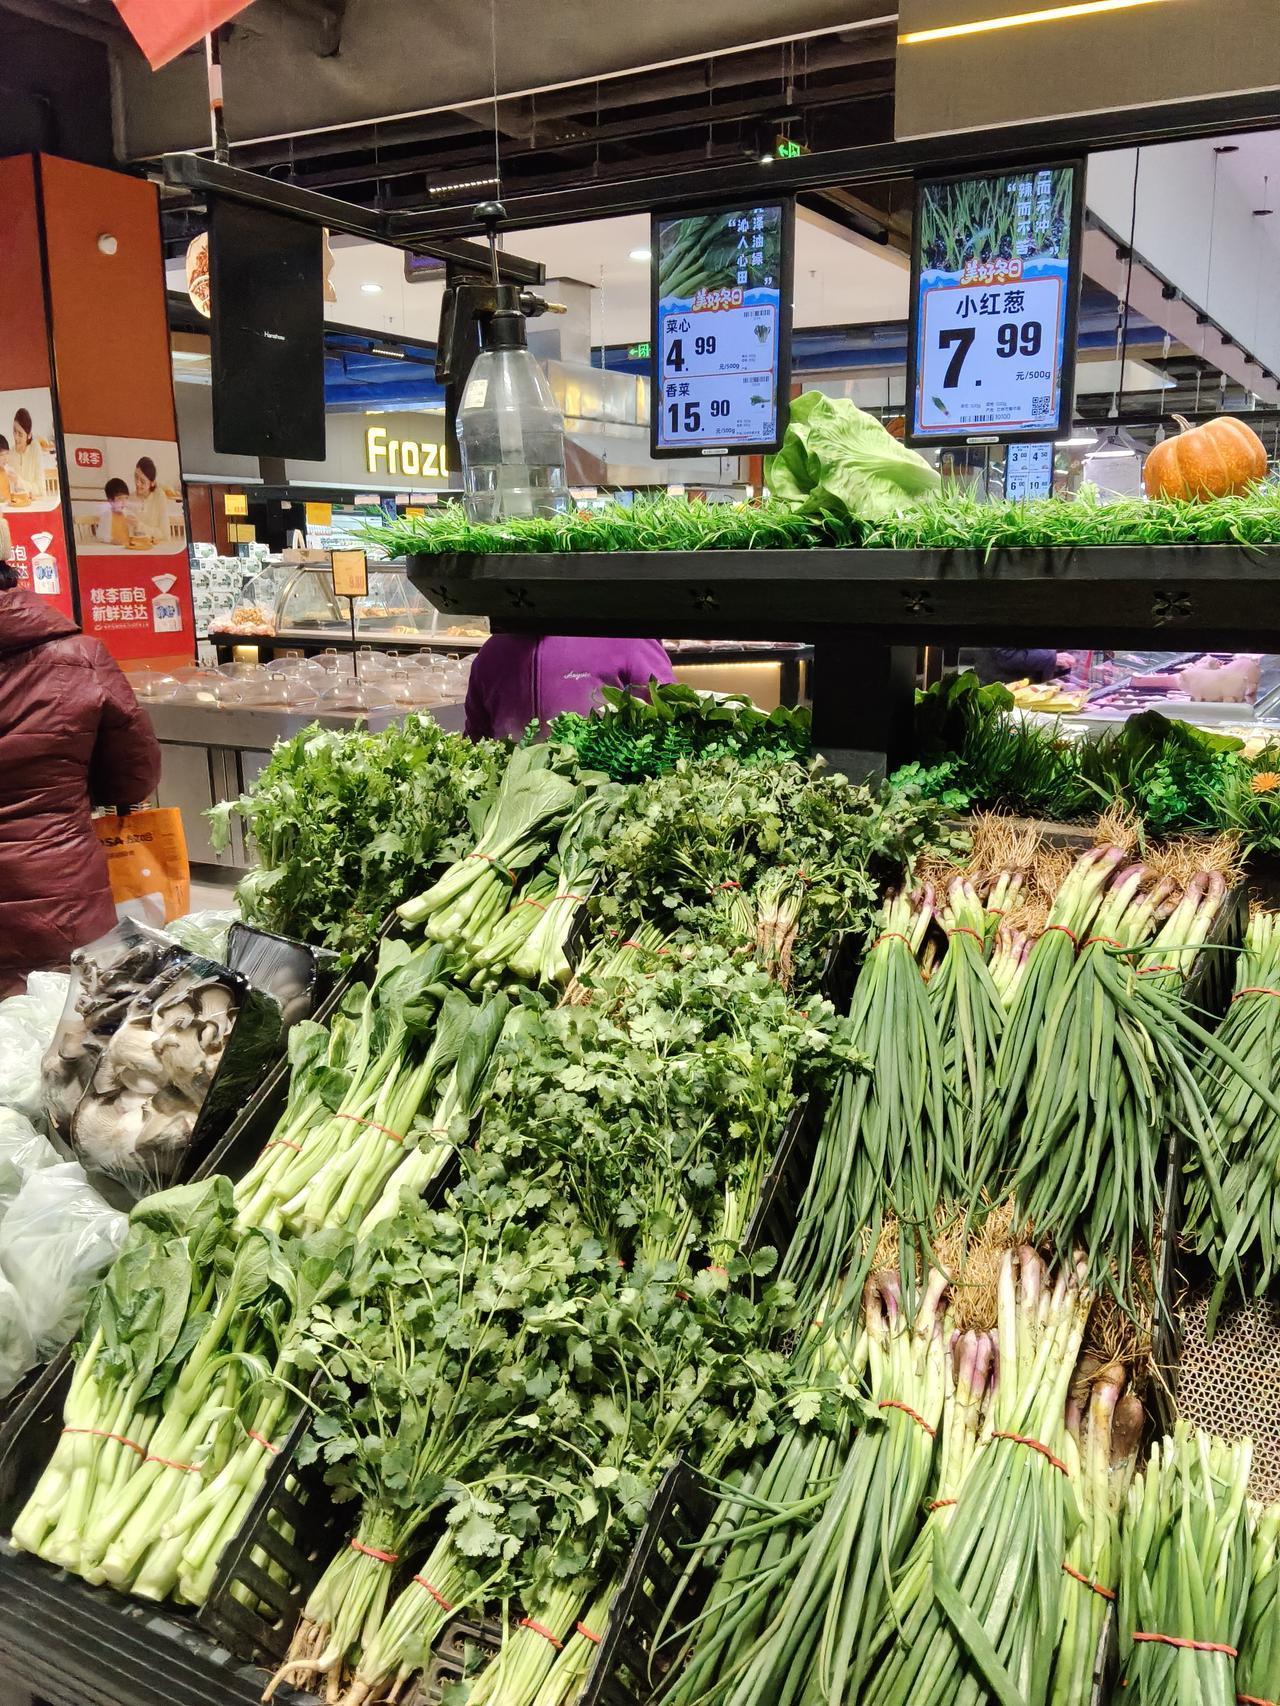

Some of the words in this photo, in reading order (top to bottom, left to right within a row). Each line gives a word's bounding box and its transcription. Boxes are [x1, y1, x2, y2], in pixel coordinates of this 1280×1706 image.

[956, 290, 1025, 318] 小红葱
[666, 319, 690, 333] 菜心
[1016, 371, 1051, 380] 元/500g
[666, 383, 690, 397] 香菜
[78, 453, 101, 465] 桃李
[91, 587, 147, 603] 桃李面包
[92, 605, 148, 621] 新鲜送达
